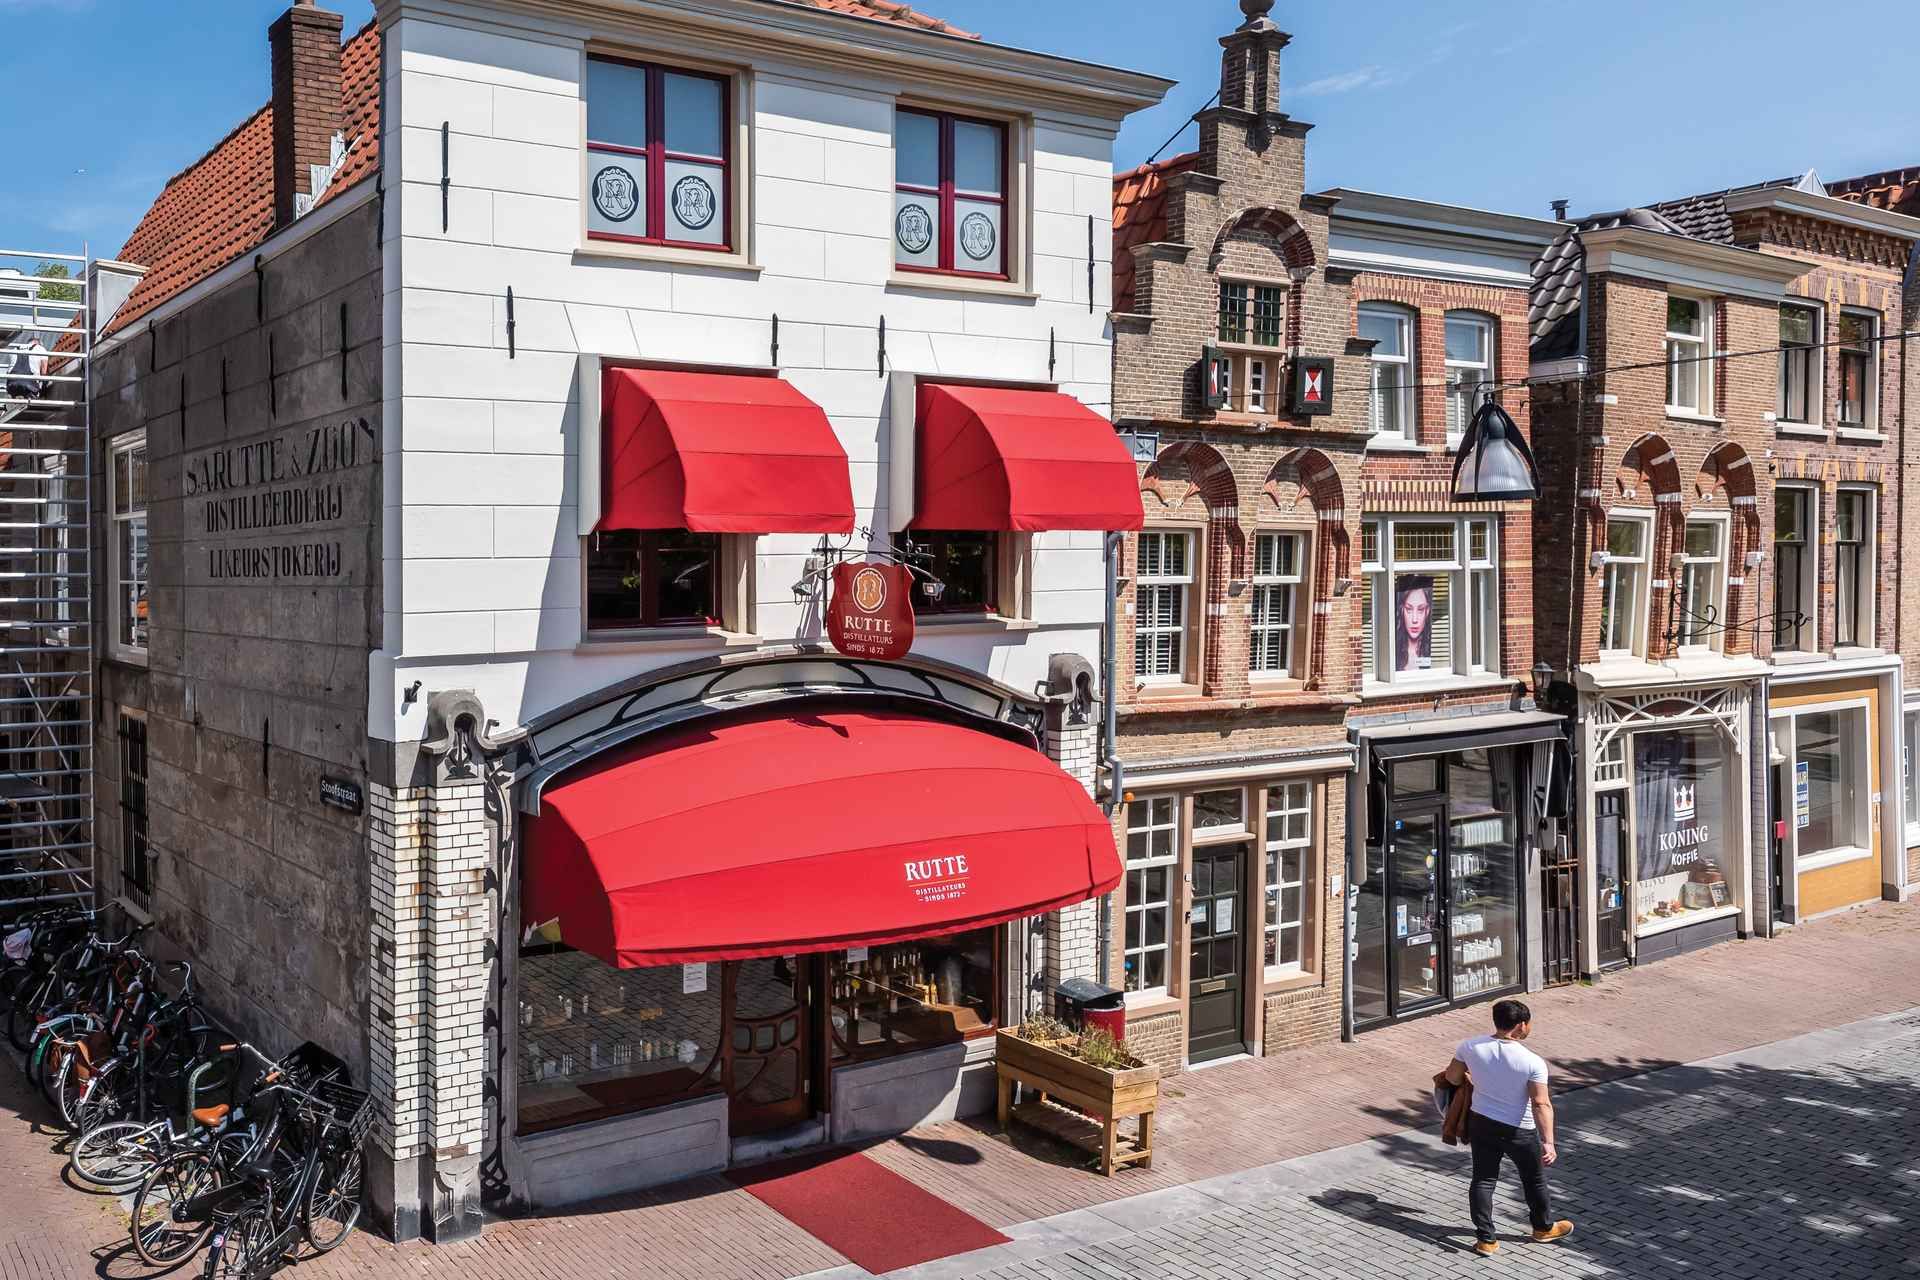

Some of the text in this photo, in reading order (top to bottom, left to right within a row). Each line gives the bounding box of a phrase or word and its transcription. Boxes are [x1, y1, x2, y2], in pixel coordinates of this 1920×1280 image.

[291, 444, 301, 479] &
[305, 416, 377, 476] ZOON
[206, 483, 343, 533] DISTILLEERDERIJ
[209, 541, 342, 579] LIKEURSTOKERIJ
[844, 615, 893, 633] RUTTE
[843, 632, 894, 645] DISTILLATEURS
[846, 643, 885, 655] SINDS 1872
[321, 780, 358, 802] Stoofstraat
[1659, 825, 1709, 851] KONING
[1671, 848, 1699, 866] KOFFIE
[904, 854, 969, 881] RUTTE
[915, 882, 966, 896] DISTILLATEURS
[924, 894, 945, 902] SINDS
